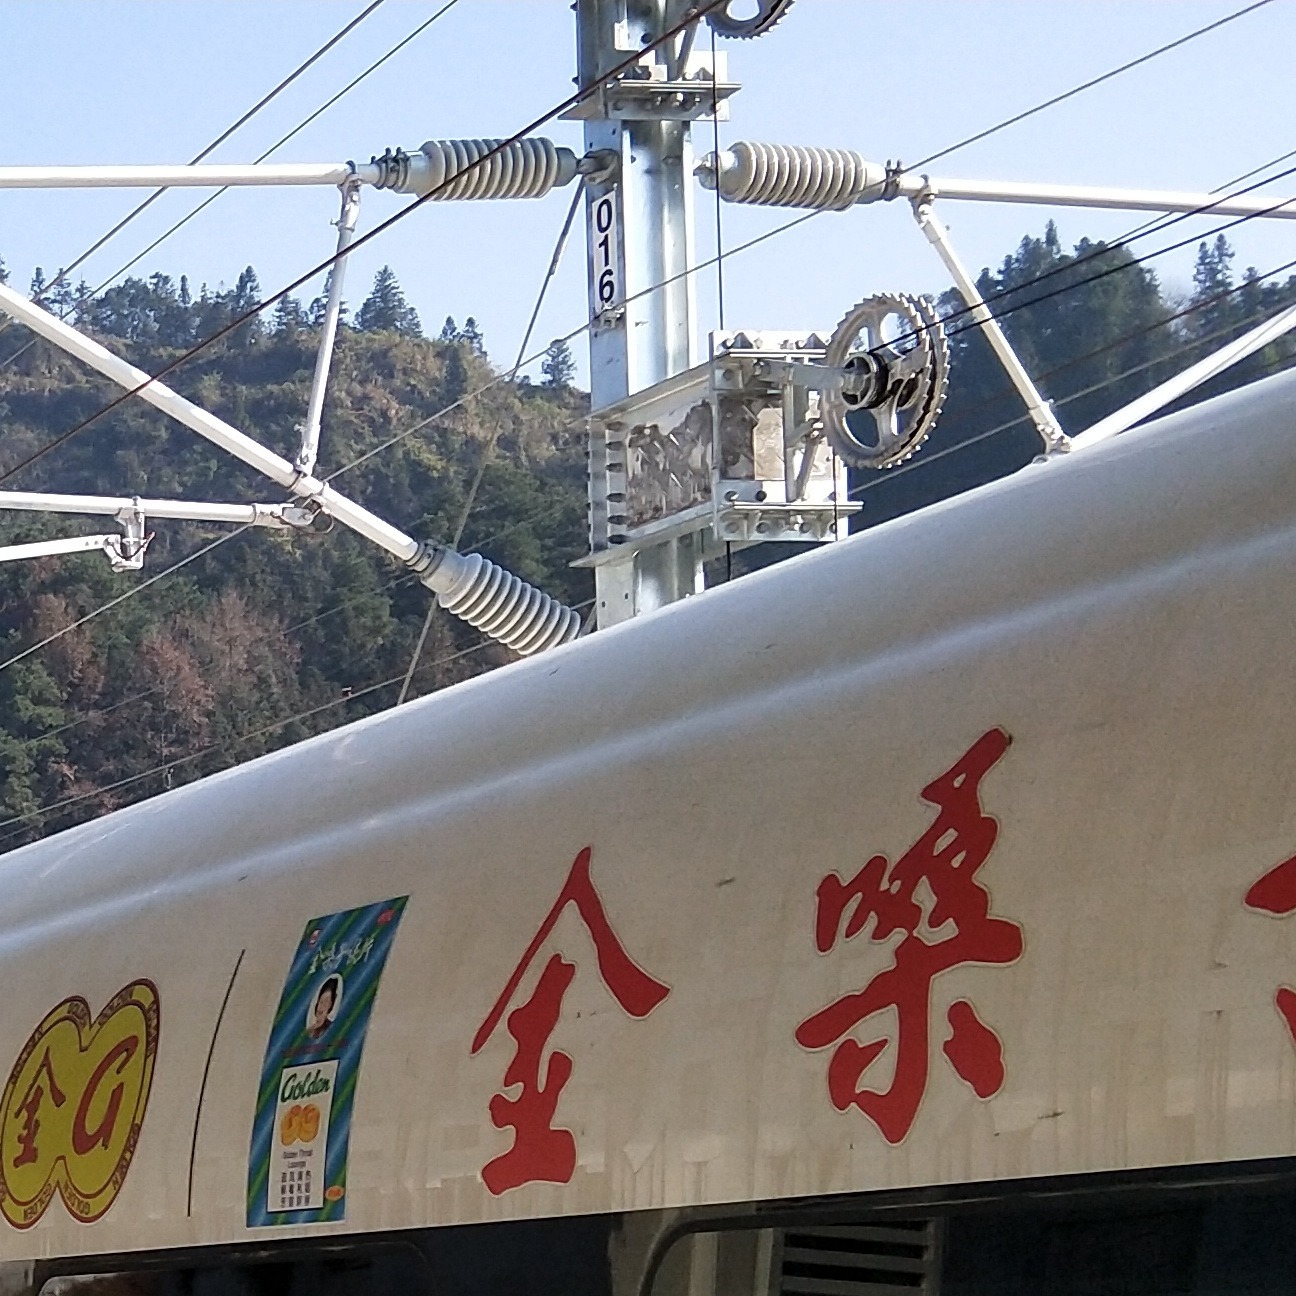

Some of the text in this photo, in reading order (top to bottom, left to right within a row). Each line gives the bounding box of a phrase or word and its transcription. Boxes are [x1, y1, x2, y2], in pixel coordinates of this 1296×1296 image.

[595, 198, 615, 304] 016
[471, 726, 1296, 1195] 金嗓
[280, 1069, 331, 1103] Golden
